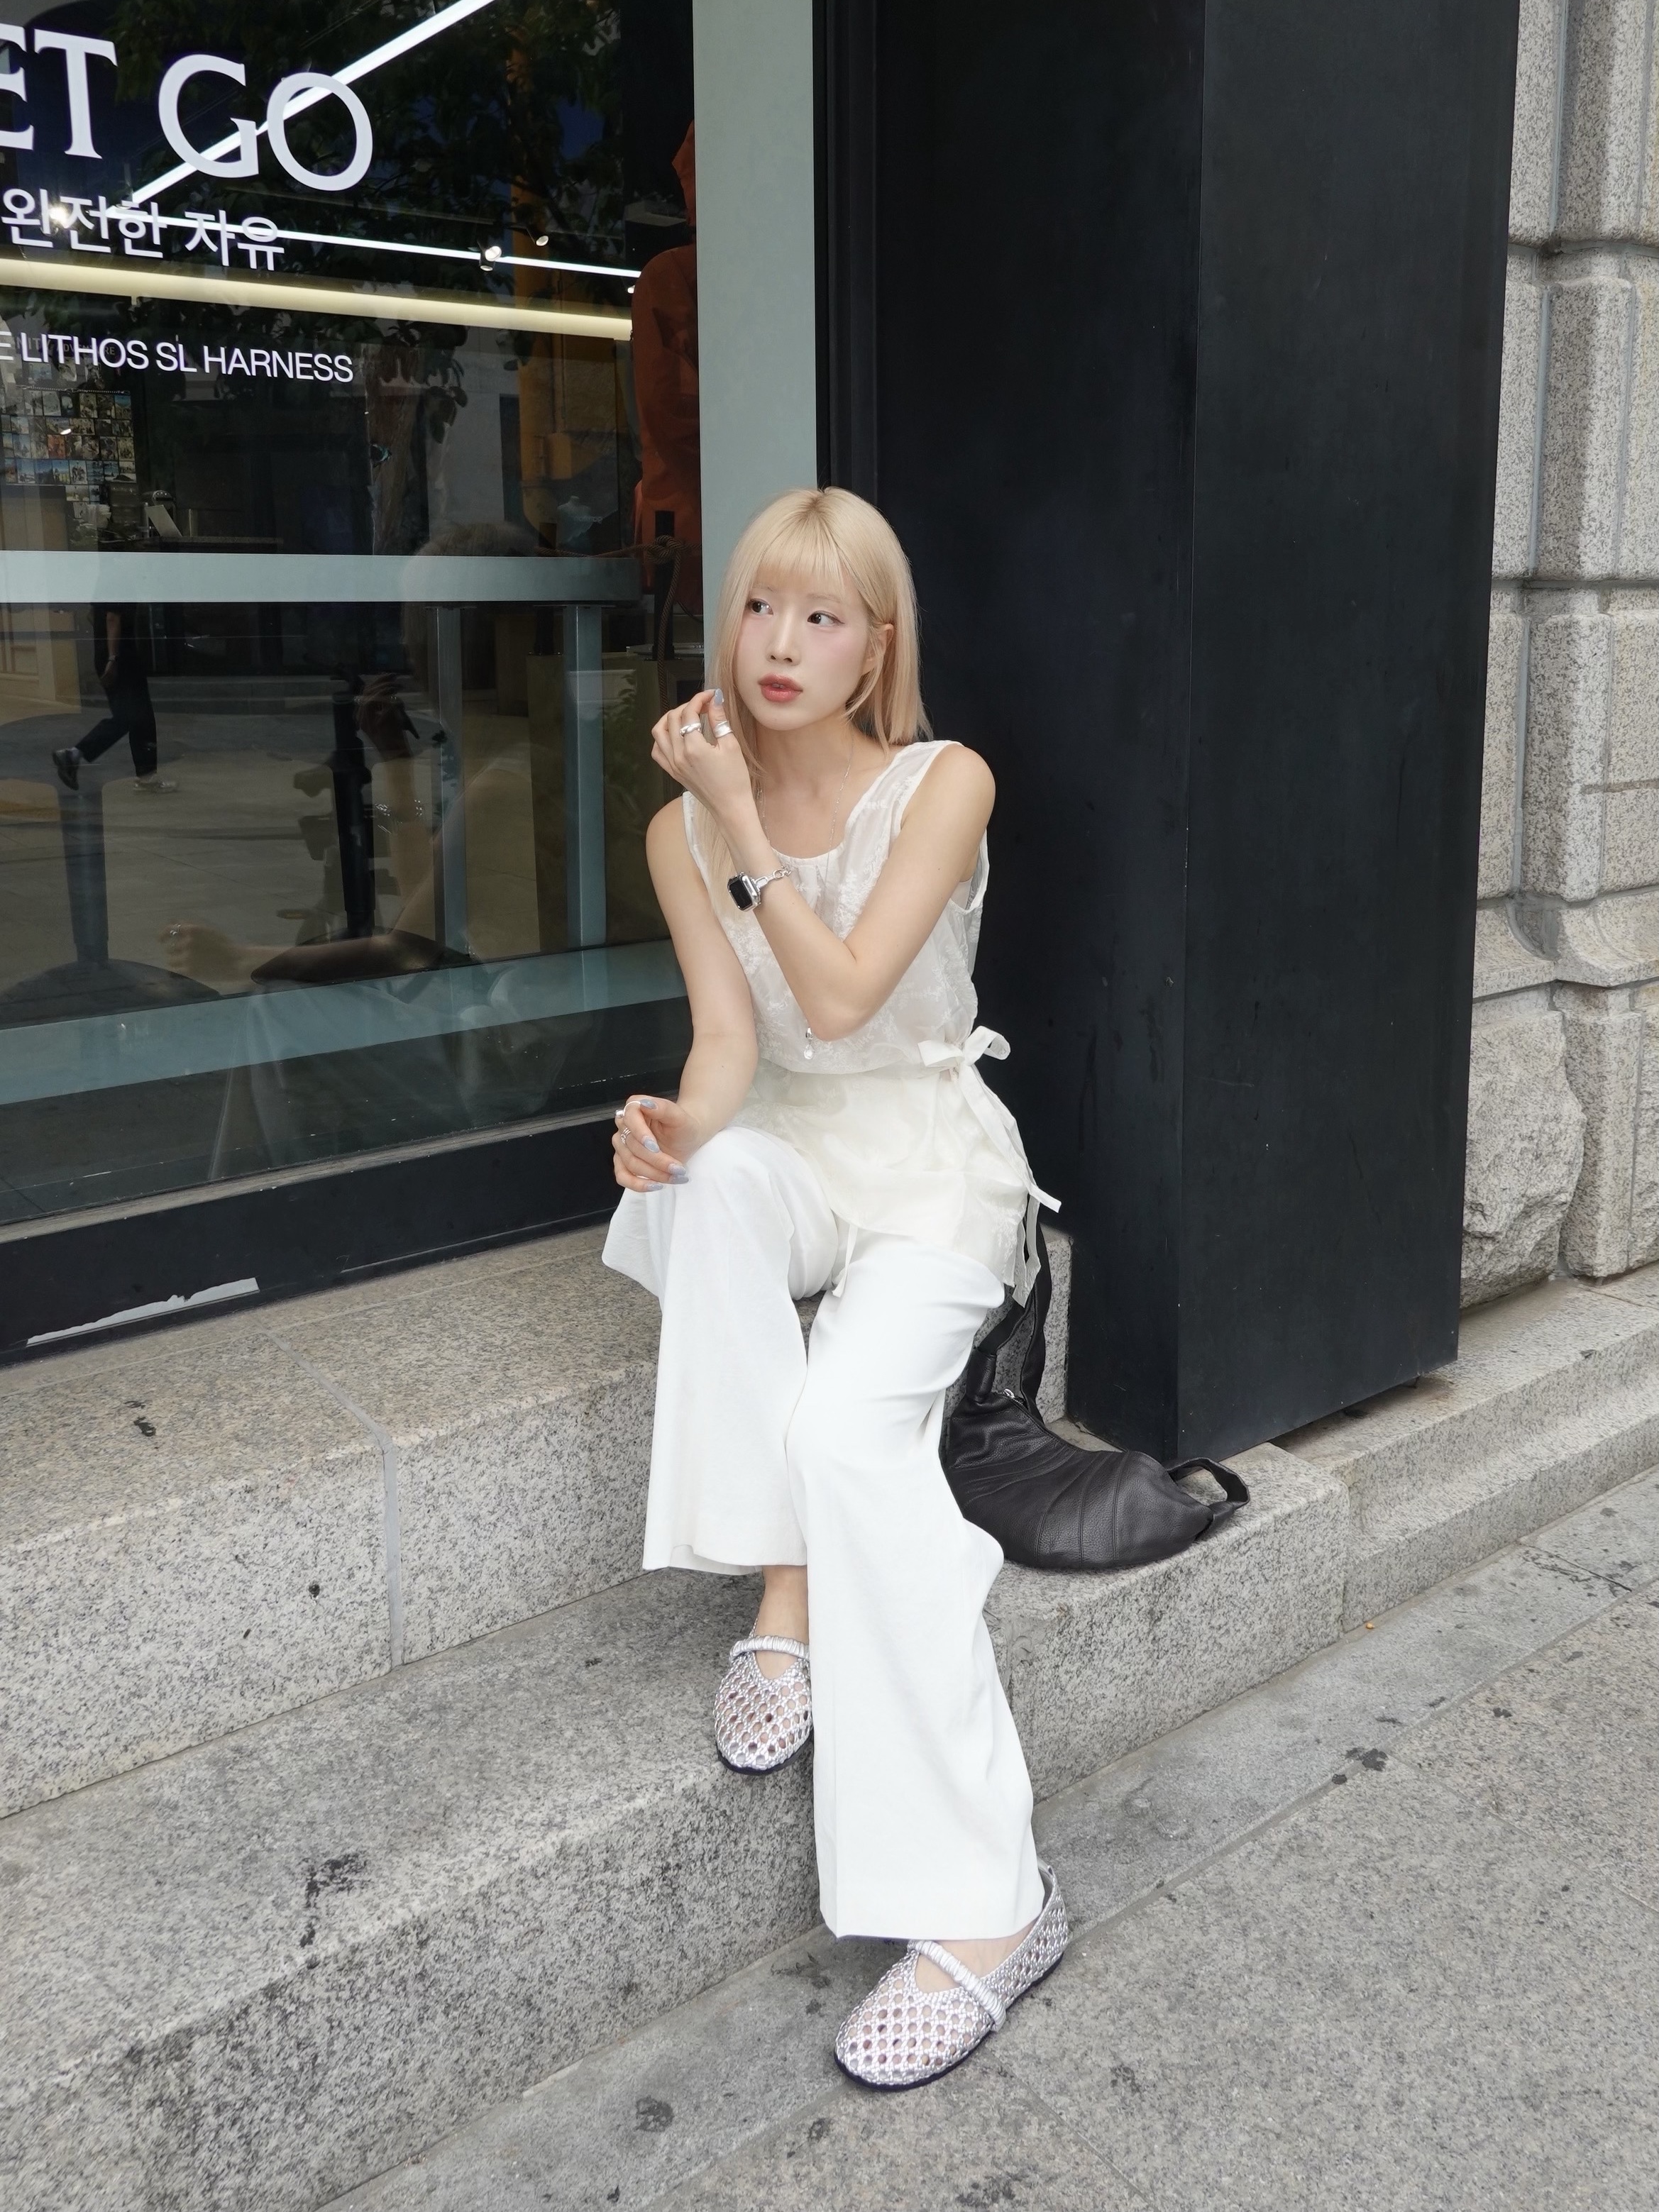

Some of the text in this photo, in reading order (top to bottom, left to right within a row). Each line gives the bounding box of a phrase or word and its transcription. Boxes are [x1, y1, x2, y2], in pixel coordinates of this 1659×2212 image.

[158, 54, 373, 192] GO
[1, 188, 285, 271] 완전한 자유
[21, 332, 149, 370] LITHOS
[156, 342, 197, 372] SL
[204, 345, 353, 382] HARNESS
